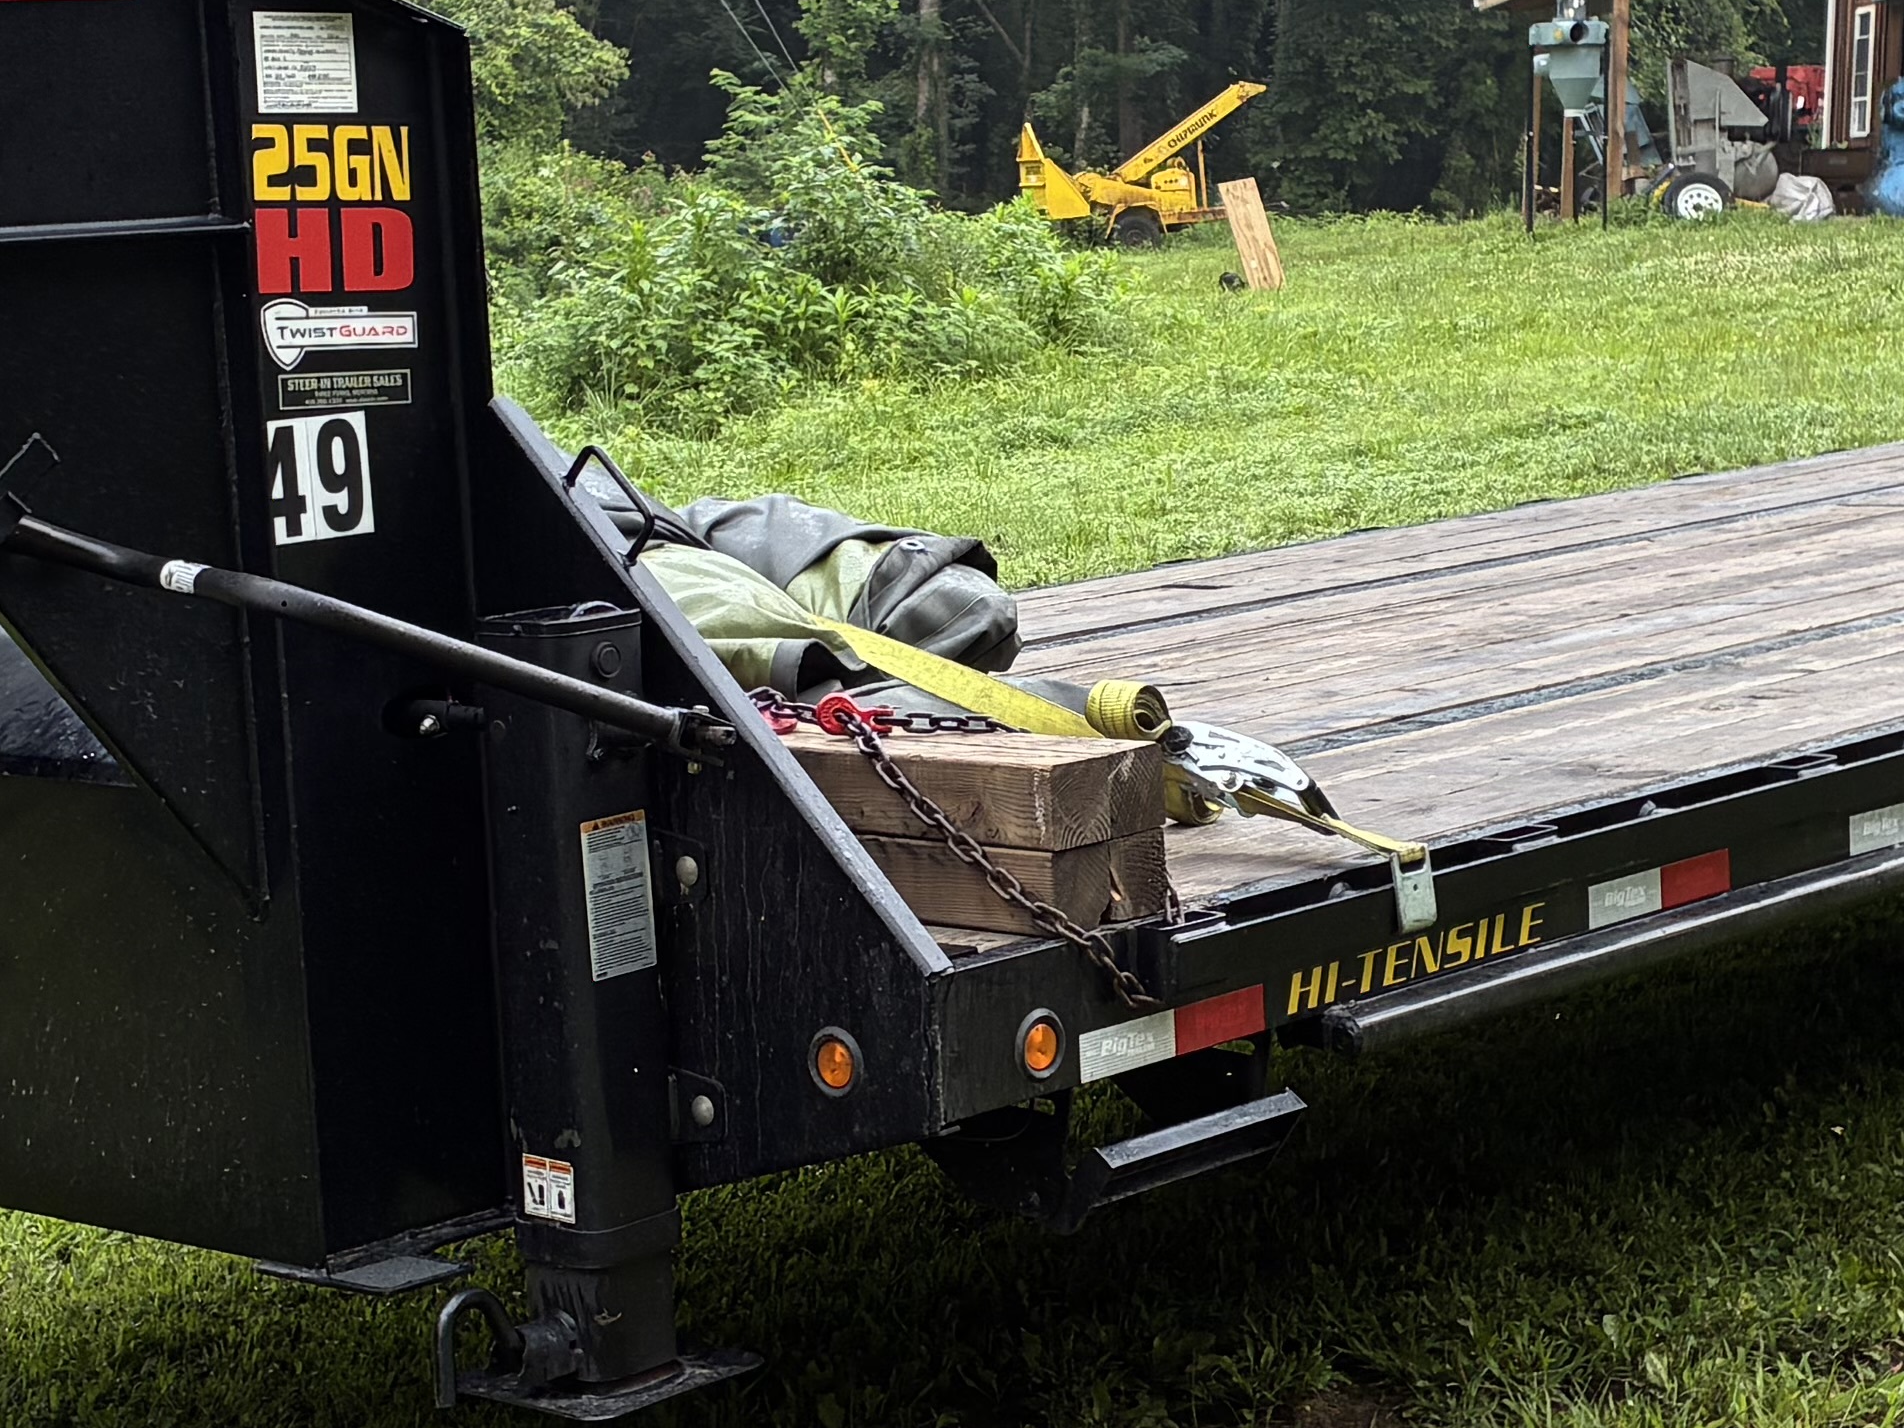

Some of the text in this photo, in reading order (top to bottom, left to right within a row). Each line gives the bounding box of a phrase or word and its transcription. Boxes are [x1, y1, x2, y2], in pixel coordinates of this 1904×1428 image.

[252, 124, 411, 201] 25GN
[255, 207, 414, 294] HD
[332, 374, 374, 390] TRAILER
[373, 373, 403, 388] SALES
[269, 418, 364, 538] 49
[1287, 902, 1545, 1016] HI-TENSILE
[1101, 1031, 1154, 1056] BigTex
